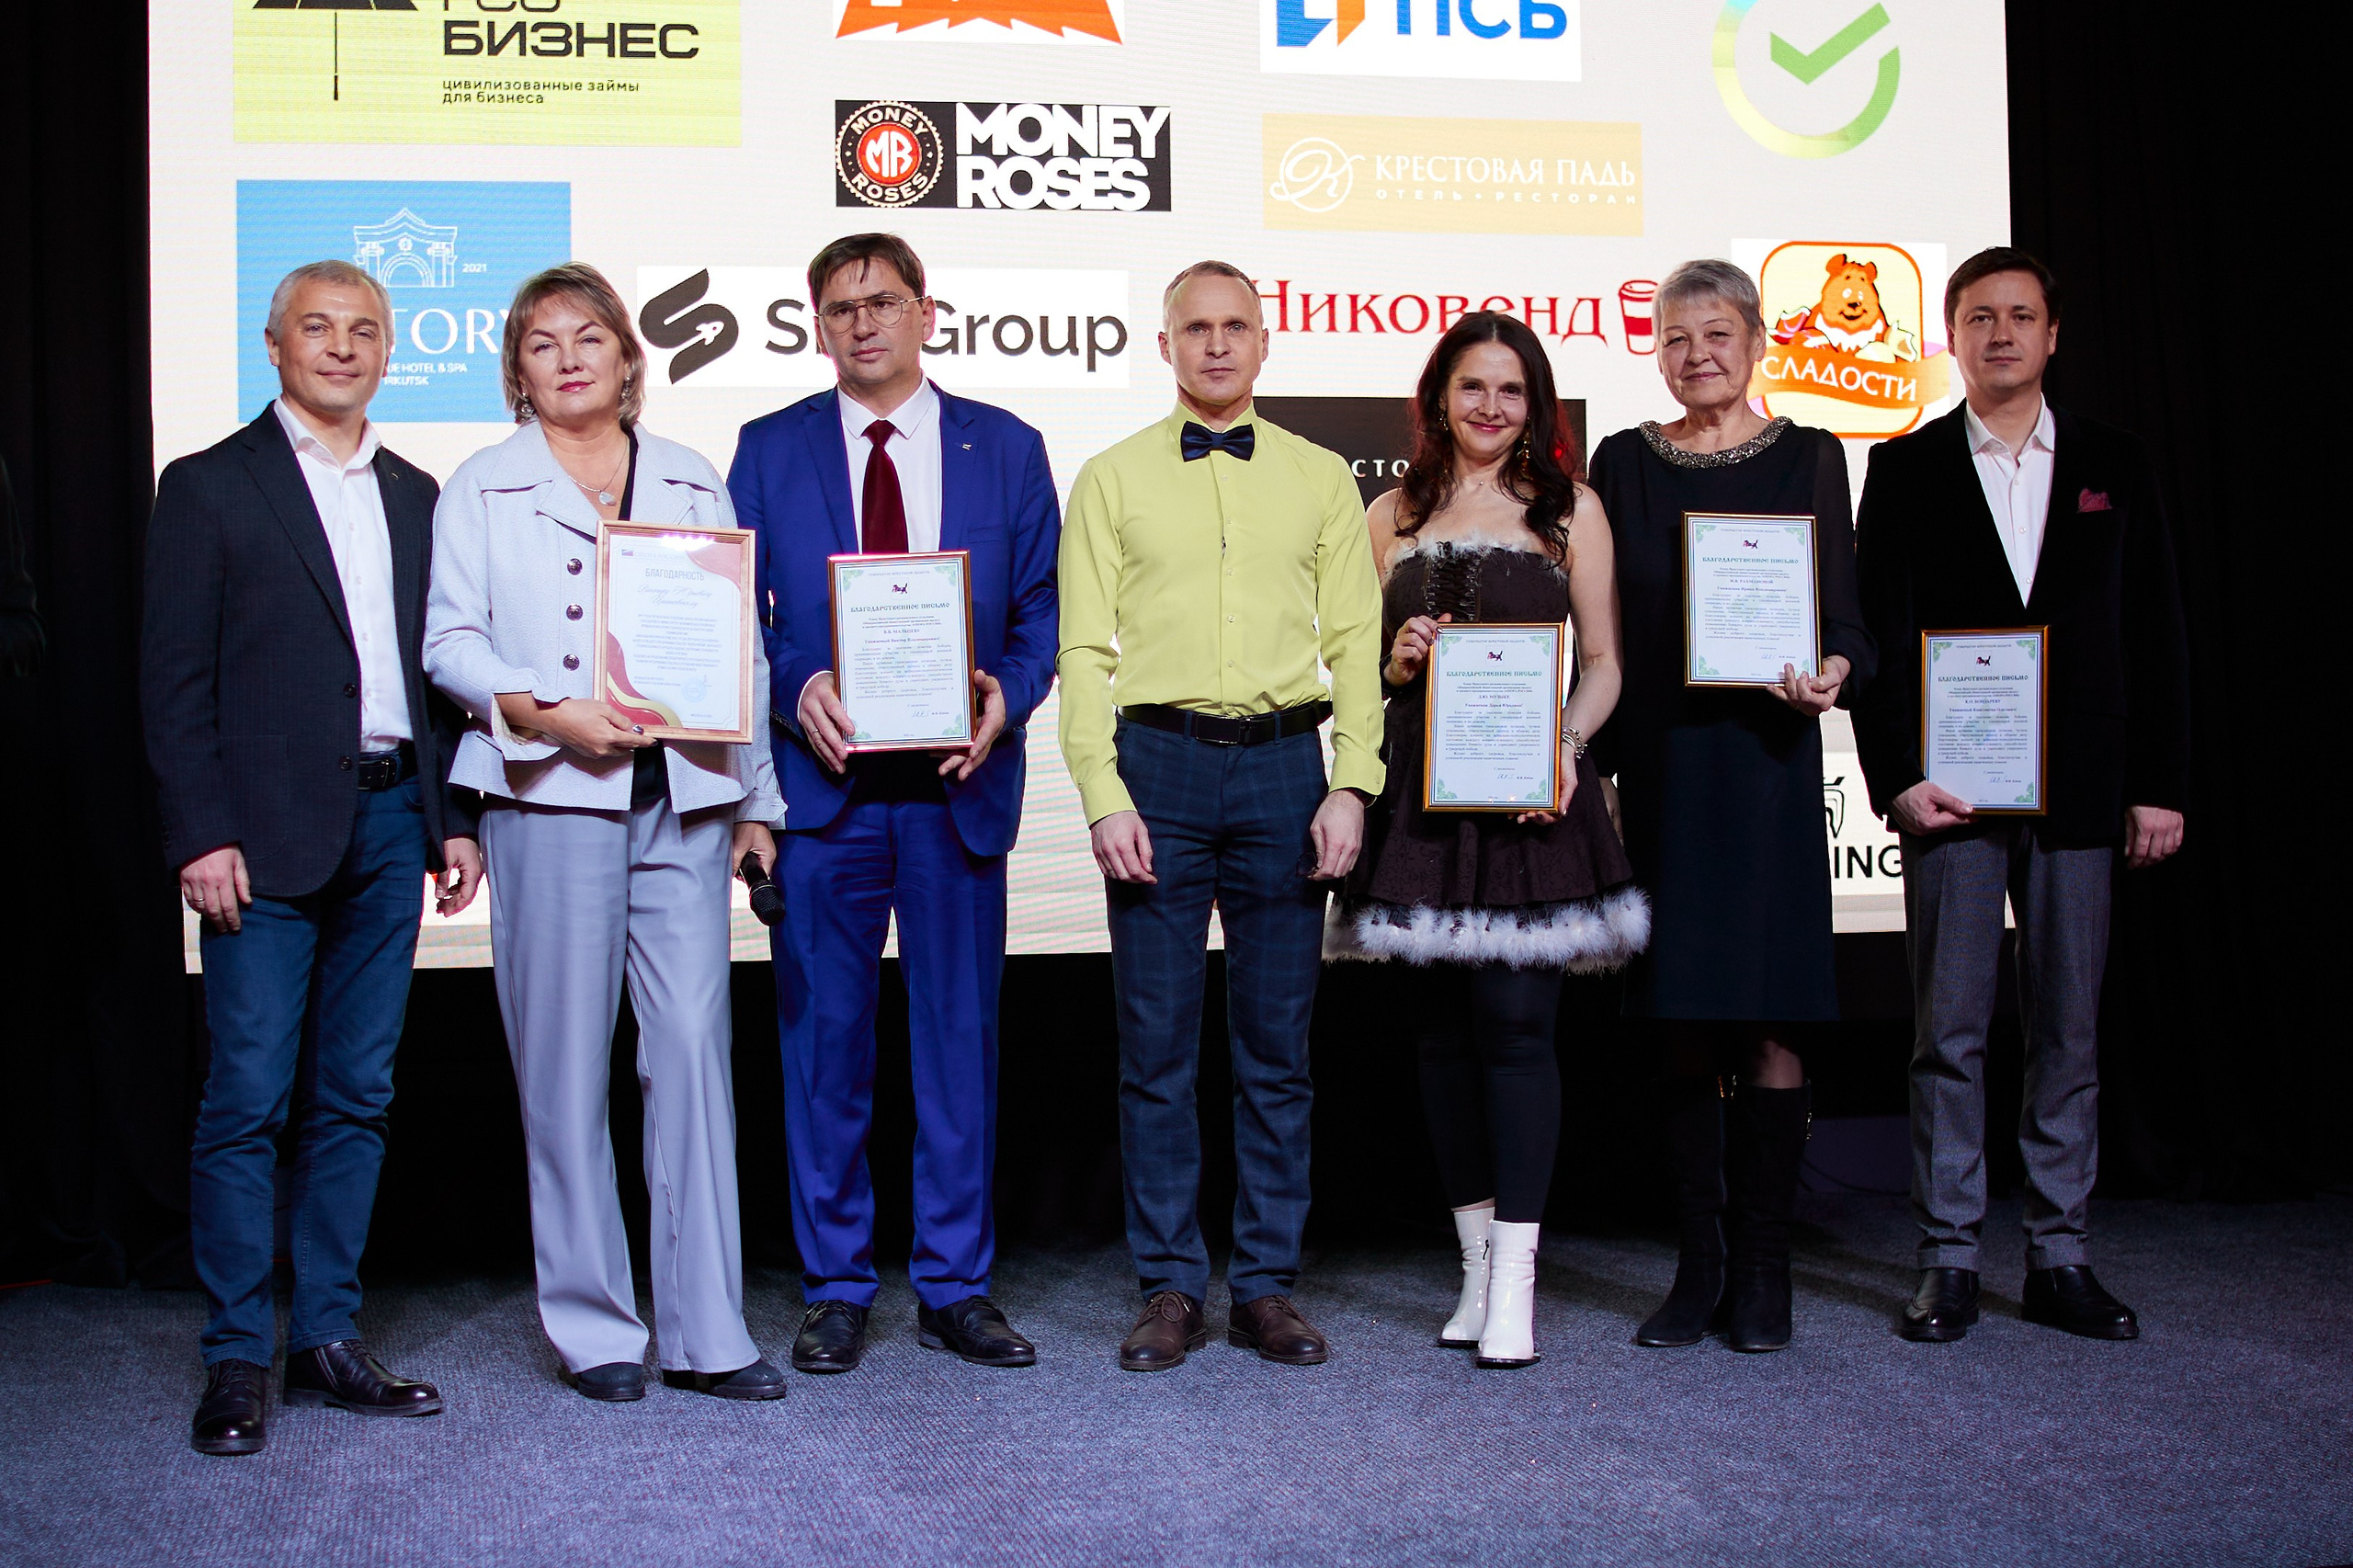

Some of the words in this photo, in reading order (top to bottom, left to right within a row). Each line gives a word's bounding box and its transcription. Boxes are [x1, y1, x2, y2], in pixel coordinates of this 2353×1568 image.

[443, 19, 699, 59] БИЗНЕС
[442, 80, 583, 92] цивилизованные
[588, 79, 640, 92] займы
[442, 93, 472, 104] для
[477, 91, 544, 104] бизнеса
[850, 107, 929, 135] MONEY
[955, 102, 1171, 159] MONEY
[1375, 154, 1543, 184] КРЕСТОВАЯ
[1556, 159, 1636, 187] ПАДЬ
[851, 172, 928, 202] ROSES
[956, 155, 1151, 211] ROSES
[1375, 188, 1463, 201] ОТЕЛЬ
[1495, 191, 1637, 205] РЕСТОРАН
[461, 263, 487, 273] 2021
[921, 300, 1128, 372] Group
[400, 362, 437, 373] HOTEL
[438, 363, 447, 373] &
[447, 363, 469, 373] SPA
[383, 375, 430, 386] IRKUTSK
[1760, 356, 1917, 402] СЛАДОСТИ
[645, 568, 705, 581] БЛАГОДАРНОСТЬ
[850, 604, 919, 613] БЛАГОДАРСТВЕННОЕ
[921, 602, 950, 610] ПИСЬМО
